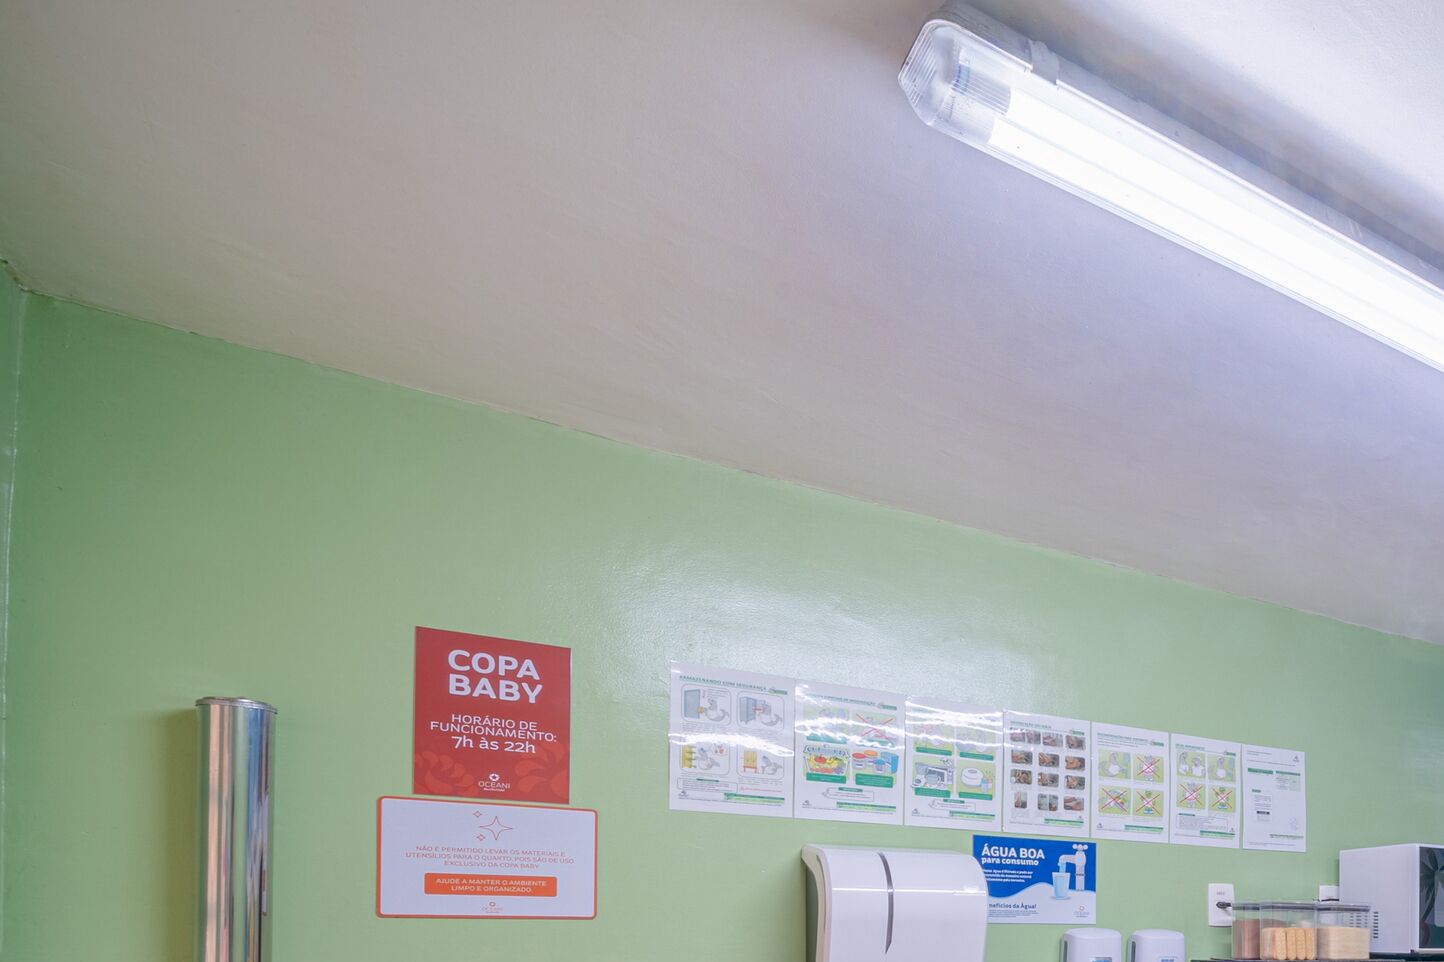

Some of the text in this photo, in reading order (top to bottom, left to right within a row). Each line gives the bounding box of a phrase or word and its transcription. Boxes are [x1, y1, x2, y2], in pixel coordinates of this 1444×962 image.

[448, 649, 540, 680] COPA
[448, 673, 543, 703] BABY
[451, 714, 537, 731] HORÁRIO DE
[430, 721, 557, 743] FUNCIONAMENTO:
[451, 735, 536, 753] 7h às 22h
[478, 780, 511, 789] OCEANI
[441, 846, 483, 854] PERMITIDO
[981, 843, 1045, 859] ÁGUA BOA
[1001, 858, 1039, 866] consumo
